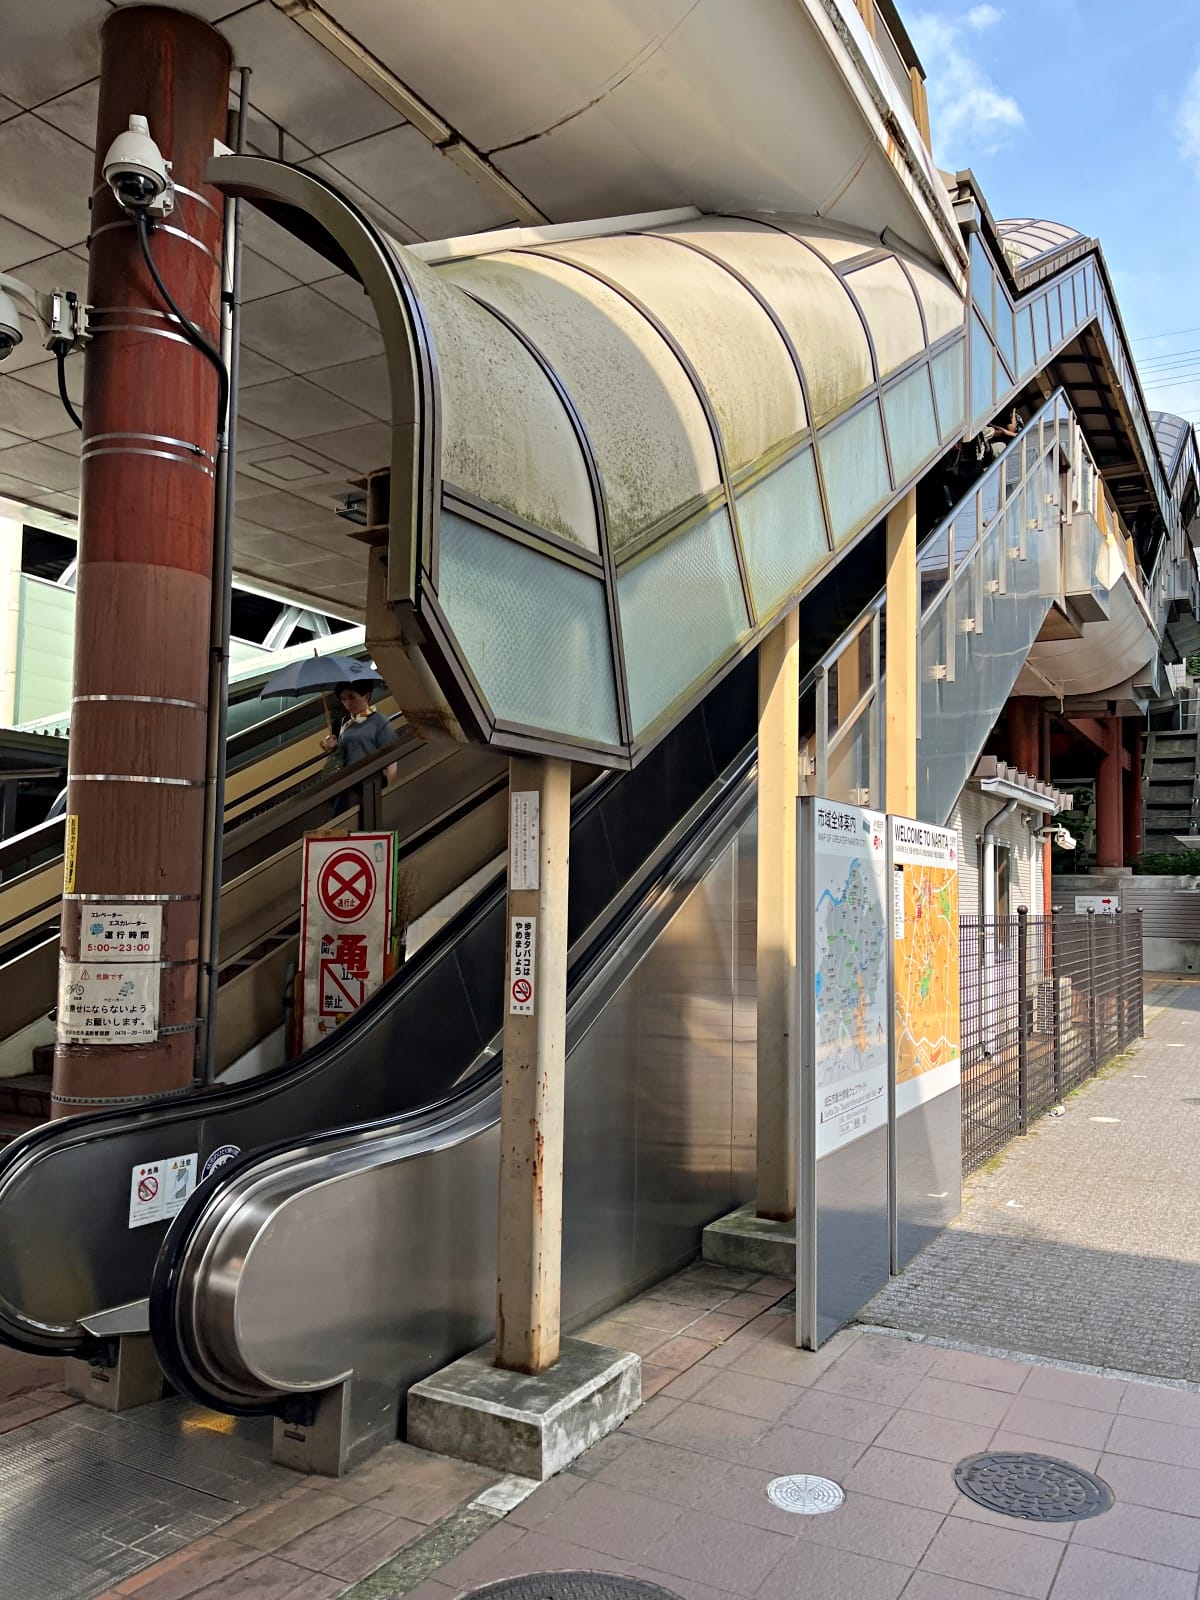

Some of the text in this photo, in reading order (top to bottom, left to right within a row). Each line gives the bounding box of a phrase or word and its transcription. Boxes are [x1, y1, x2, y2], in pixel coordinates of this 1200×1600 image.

[818, 809, 856, 834] 市域全体案内
[894, 823, 923, 846] WELCOME
[923, 830, 931, 847] TO
[931, 832, 949, 851] NARITA
[104, 930, 150, 940] 運行時間
[514, 922, 523, 976] やめましょう
[523, 922, 532, 976] 歩きタバコは
[324, 994, 344, 1009] 禁止
[85, 1017, 145, 1027] お願いします。
